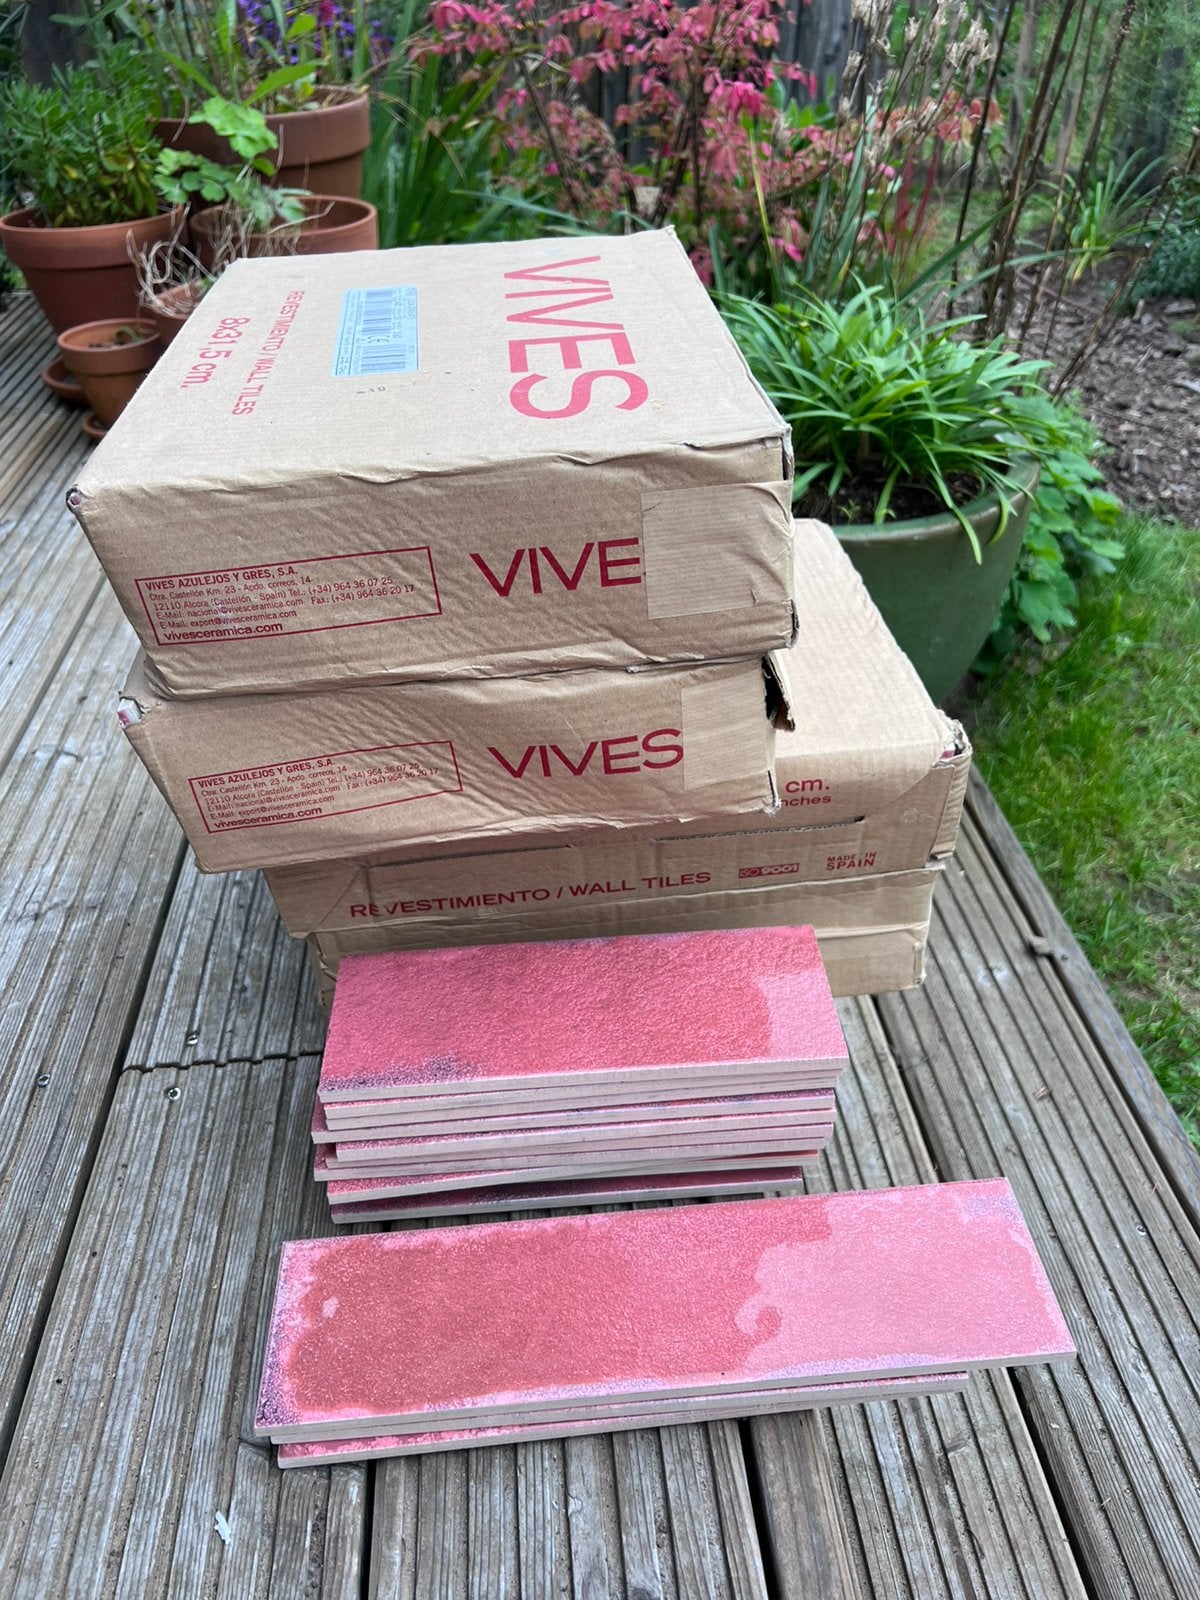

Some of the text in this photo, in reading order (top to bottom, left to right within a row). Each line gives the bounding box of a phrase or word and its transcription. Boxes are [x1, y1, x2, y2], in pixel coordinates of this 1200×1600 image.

[262, 290, 305, 351] REVESTIMIENTO
[503, 255, 649, 419] VIVES
[180, 317, 251, 389] 8x31,5 cm.
[246, 357, 277, 384] WALL
[231, 384, 264, 415] TILES
[145, 566, 298, 591] VIVES AZULEJOS Y GRES, S.A.
[469, 537, 646, 597] VIVE
[149, 592, 166, 601] Ctra.
[225, 585, 236, 594] 23
[300, 576, 311, 585] 14
[154, 602, 181, 611] 12110
[184, 600, 209, 609] Alcora
[260, 589, 286, 601] Spain)
[308, 583, 332, 595] (+34)
[333, 581, 351, 591] 964
[353, 580, 365, 589] 36
[367, 578, 378, 587] 07
[381, 576, 393, 585] 25
[156, 584, 415, 620] E-Mail: nacional@vivesceramica.com Fax: (+34) 964 36 20 17
[160, 610, 297, 629] E-Mail: export@vivesceramica.com
[164, 622, 283, 640] vivesceramica.com
[487, 728, 684, 778] VIVES
[197, 758, 335, 788] VIVES AZULEJOS Y GRES, S.A.
[253, 782, 268, 790] Km.
[270, 779, 280, 787] 23
[337, 765, 347, 774] 14
[300, 779, 325, 791] Spain)
[344, 771, 366, 782] (+34)
[368, 768, 383, 777] 964
[384, 765, 396, 774] 36
[396, 763, 407, 772] 07
[347, 781, 364, 790] Fax:
[429, 767, 439, 775] 17
[785, 779, 830, 793] cm.
[238, 795, 335, 817] export@vivesceramica.com
[780, 796, 831, 807] nches
[213, 807, 322, 829] vivesceramica.com
[826, 857, 876, 871] SPAIN
[827, 853, 858, 863] MADE
[350, 872, 712, 917] REVESTIMIENTO / WALL TILES
